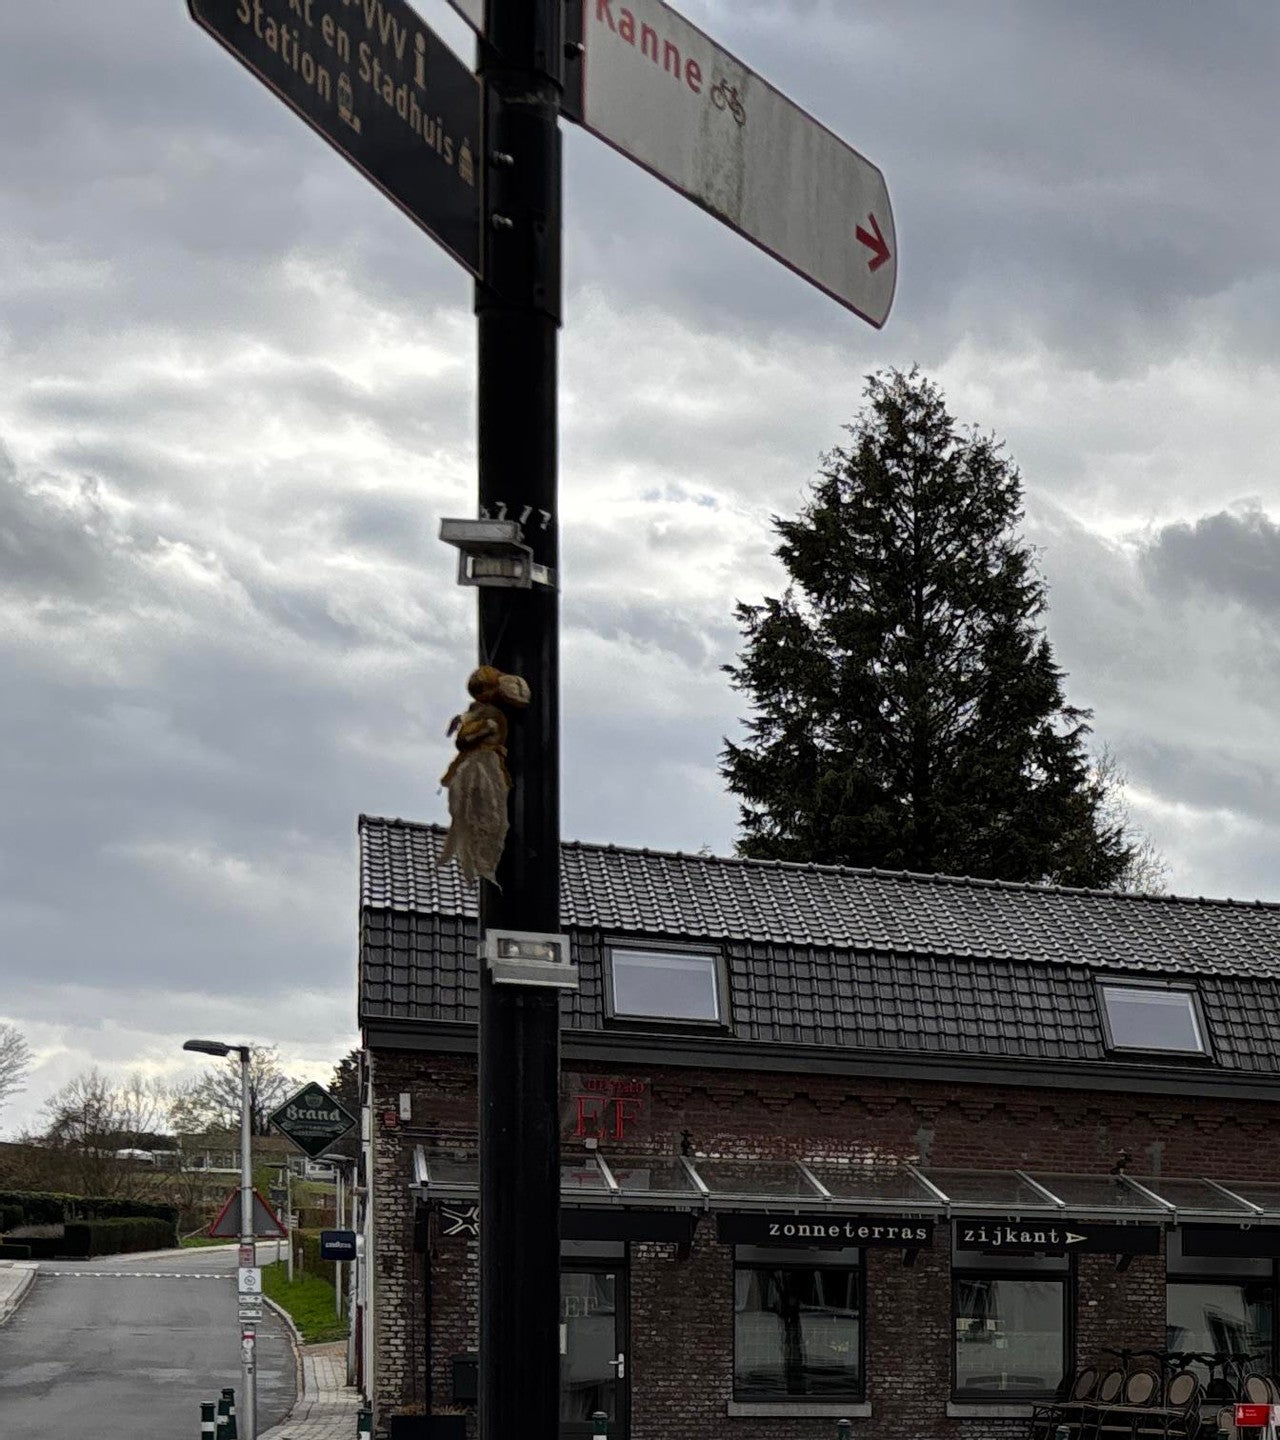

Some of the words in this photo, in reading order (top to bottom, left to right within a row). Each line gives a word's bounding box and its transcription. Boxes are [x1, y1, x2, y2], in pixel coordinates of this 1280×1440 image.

[236, 0, 331, 101] Station
[321, 13, 350, 63] en
[359, 41, 453, 165] Stadhuis
[596, 0, 703, 94] Kanne
[285, 1104, 341, 1121] Brand
[769, 1221, 927, 1241] zonneterras
[964, 1225, 1060, 1246] zijkant
